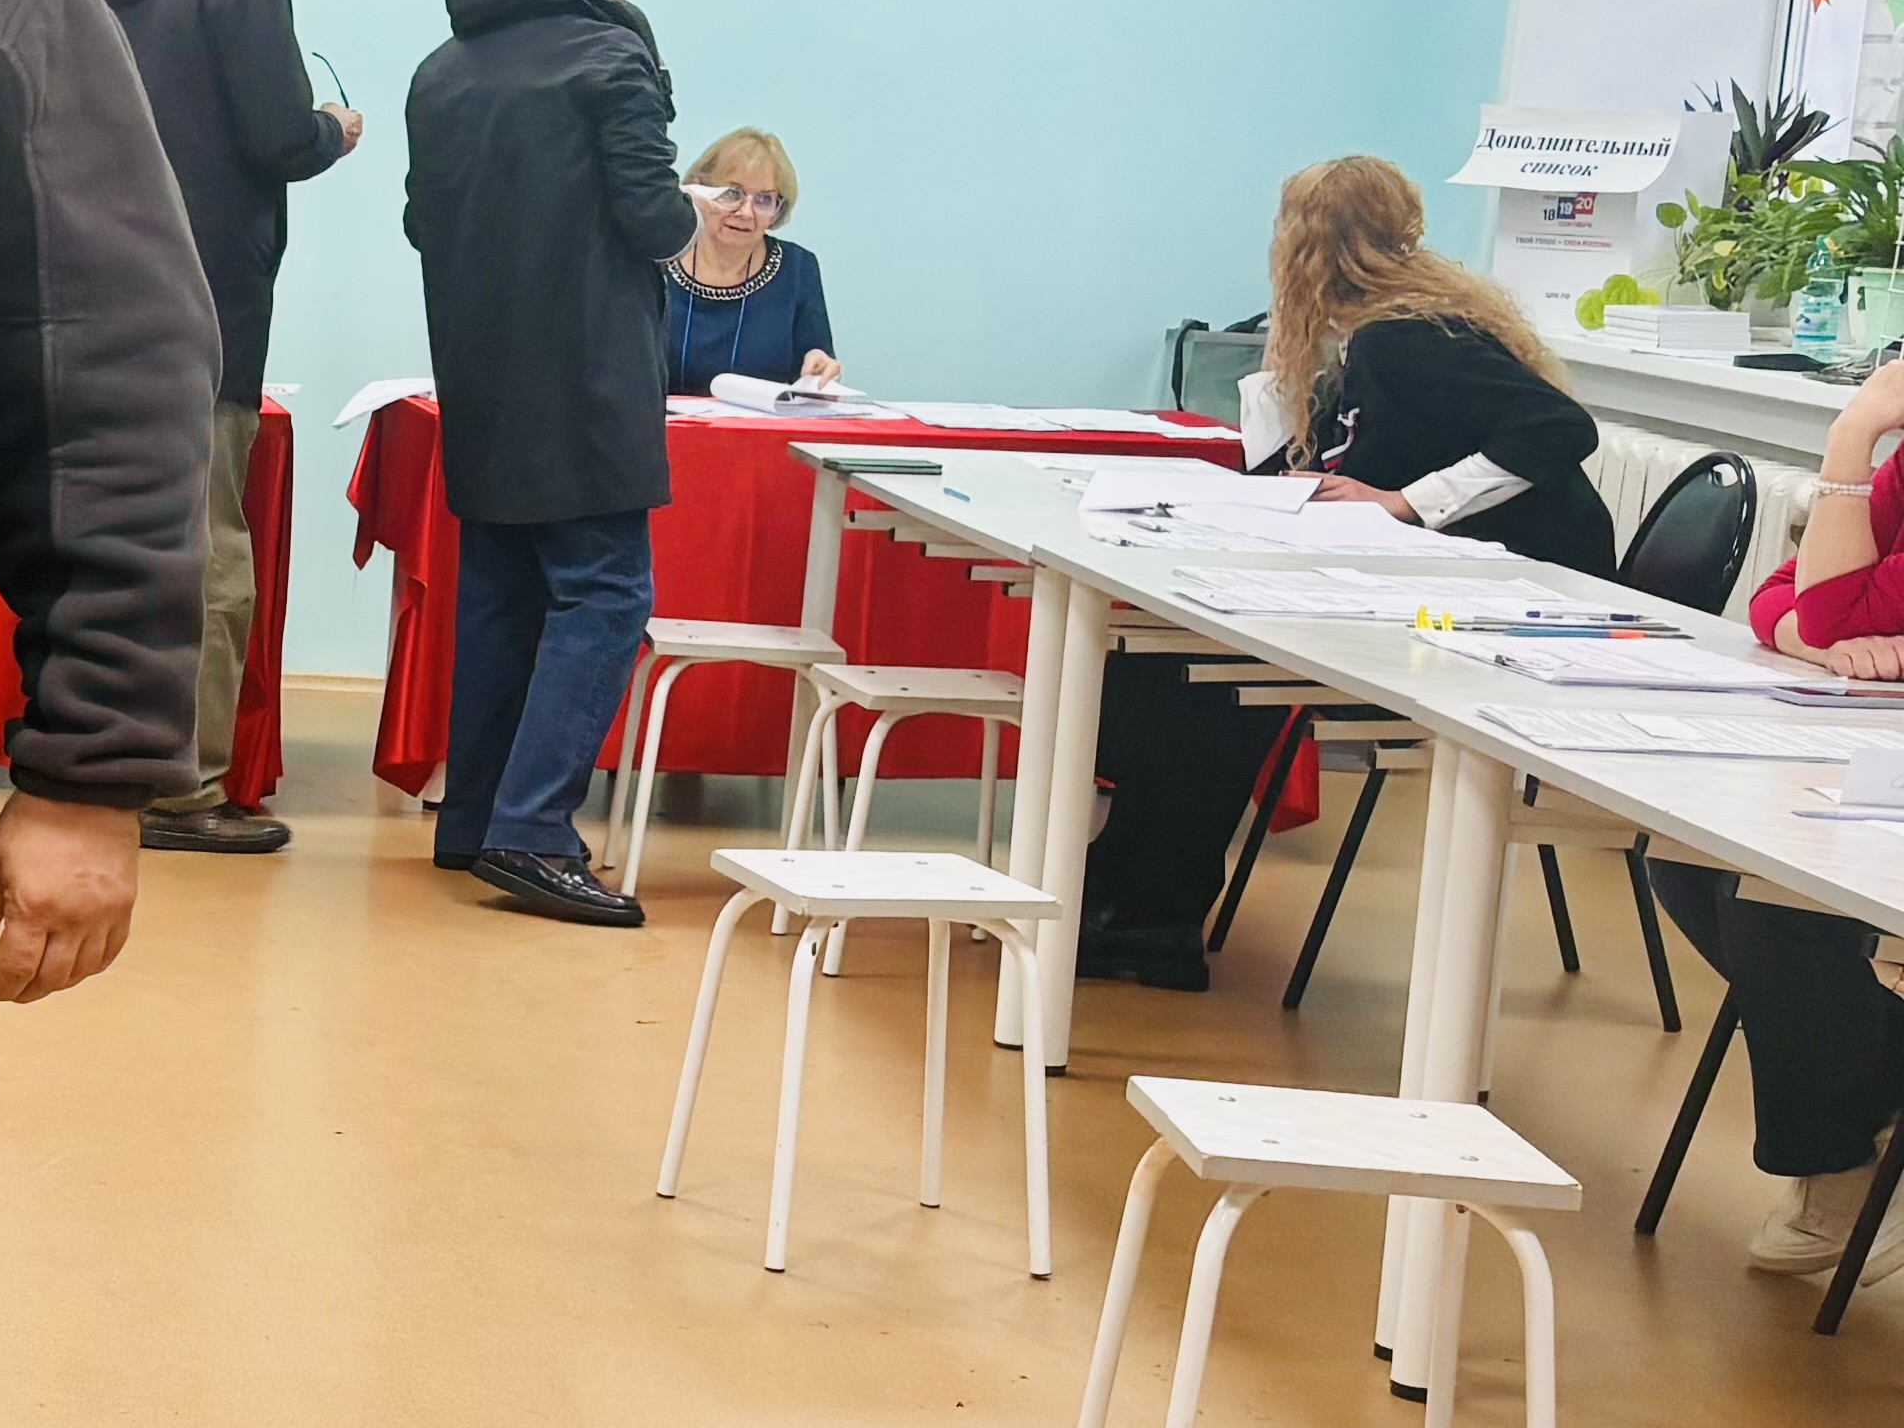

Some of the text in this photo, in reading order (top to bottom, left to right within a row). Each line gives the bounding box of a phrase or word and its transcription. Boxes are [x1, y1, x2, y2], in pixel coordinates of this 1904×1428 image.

[1477, 128, 1671, 158] Дополнительный
[1520, 161, 1599, 177] список
[1559, 201, 1573, 215] 19
[1575, 197, 1593, 210] 20
